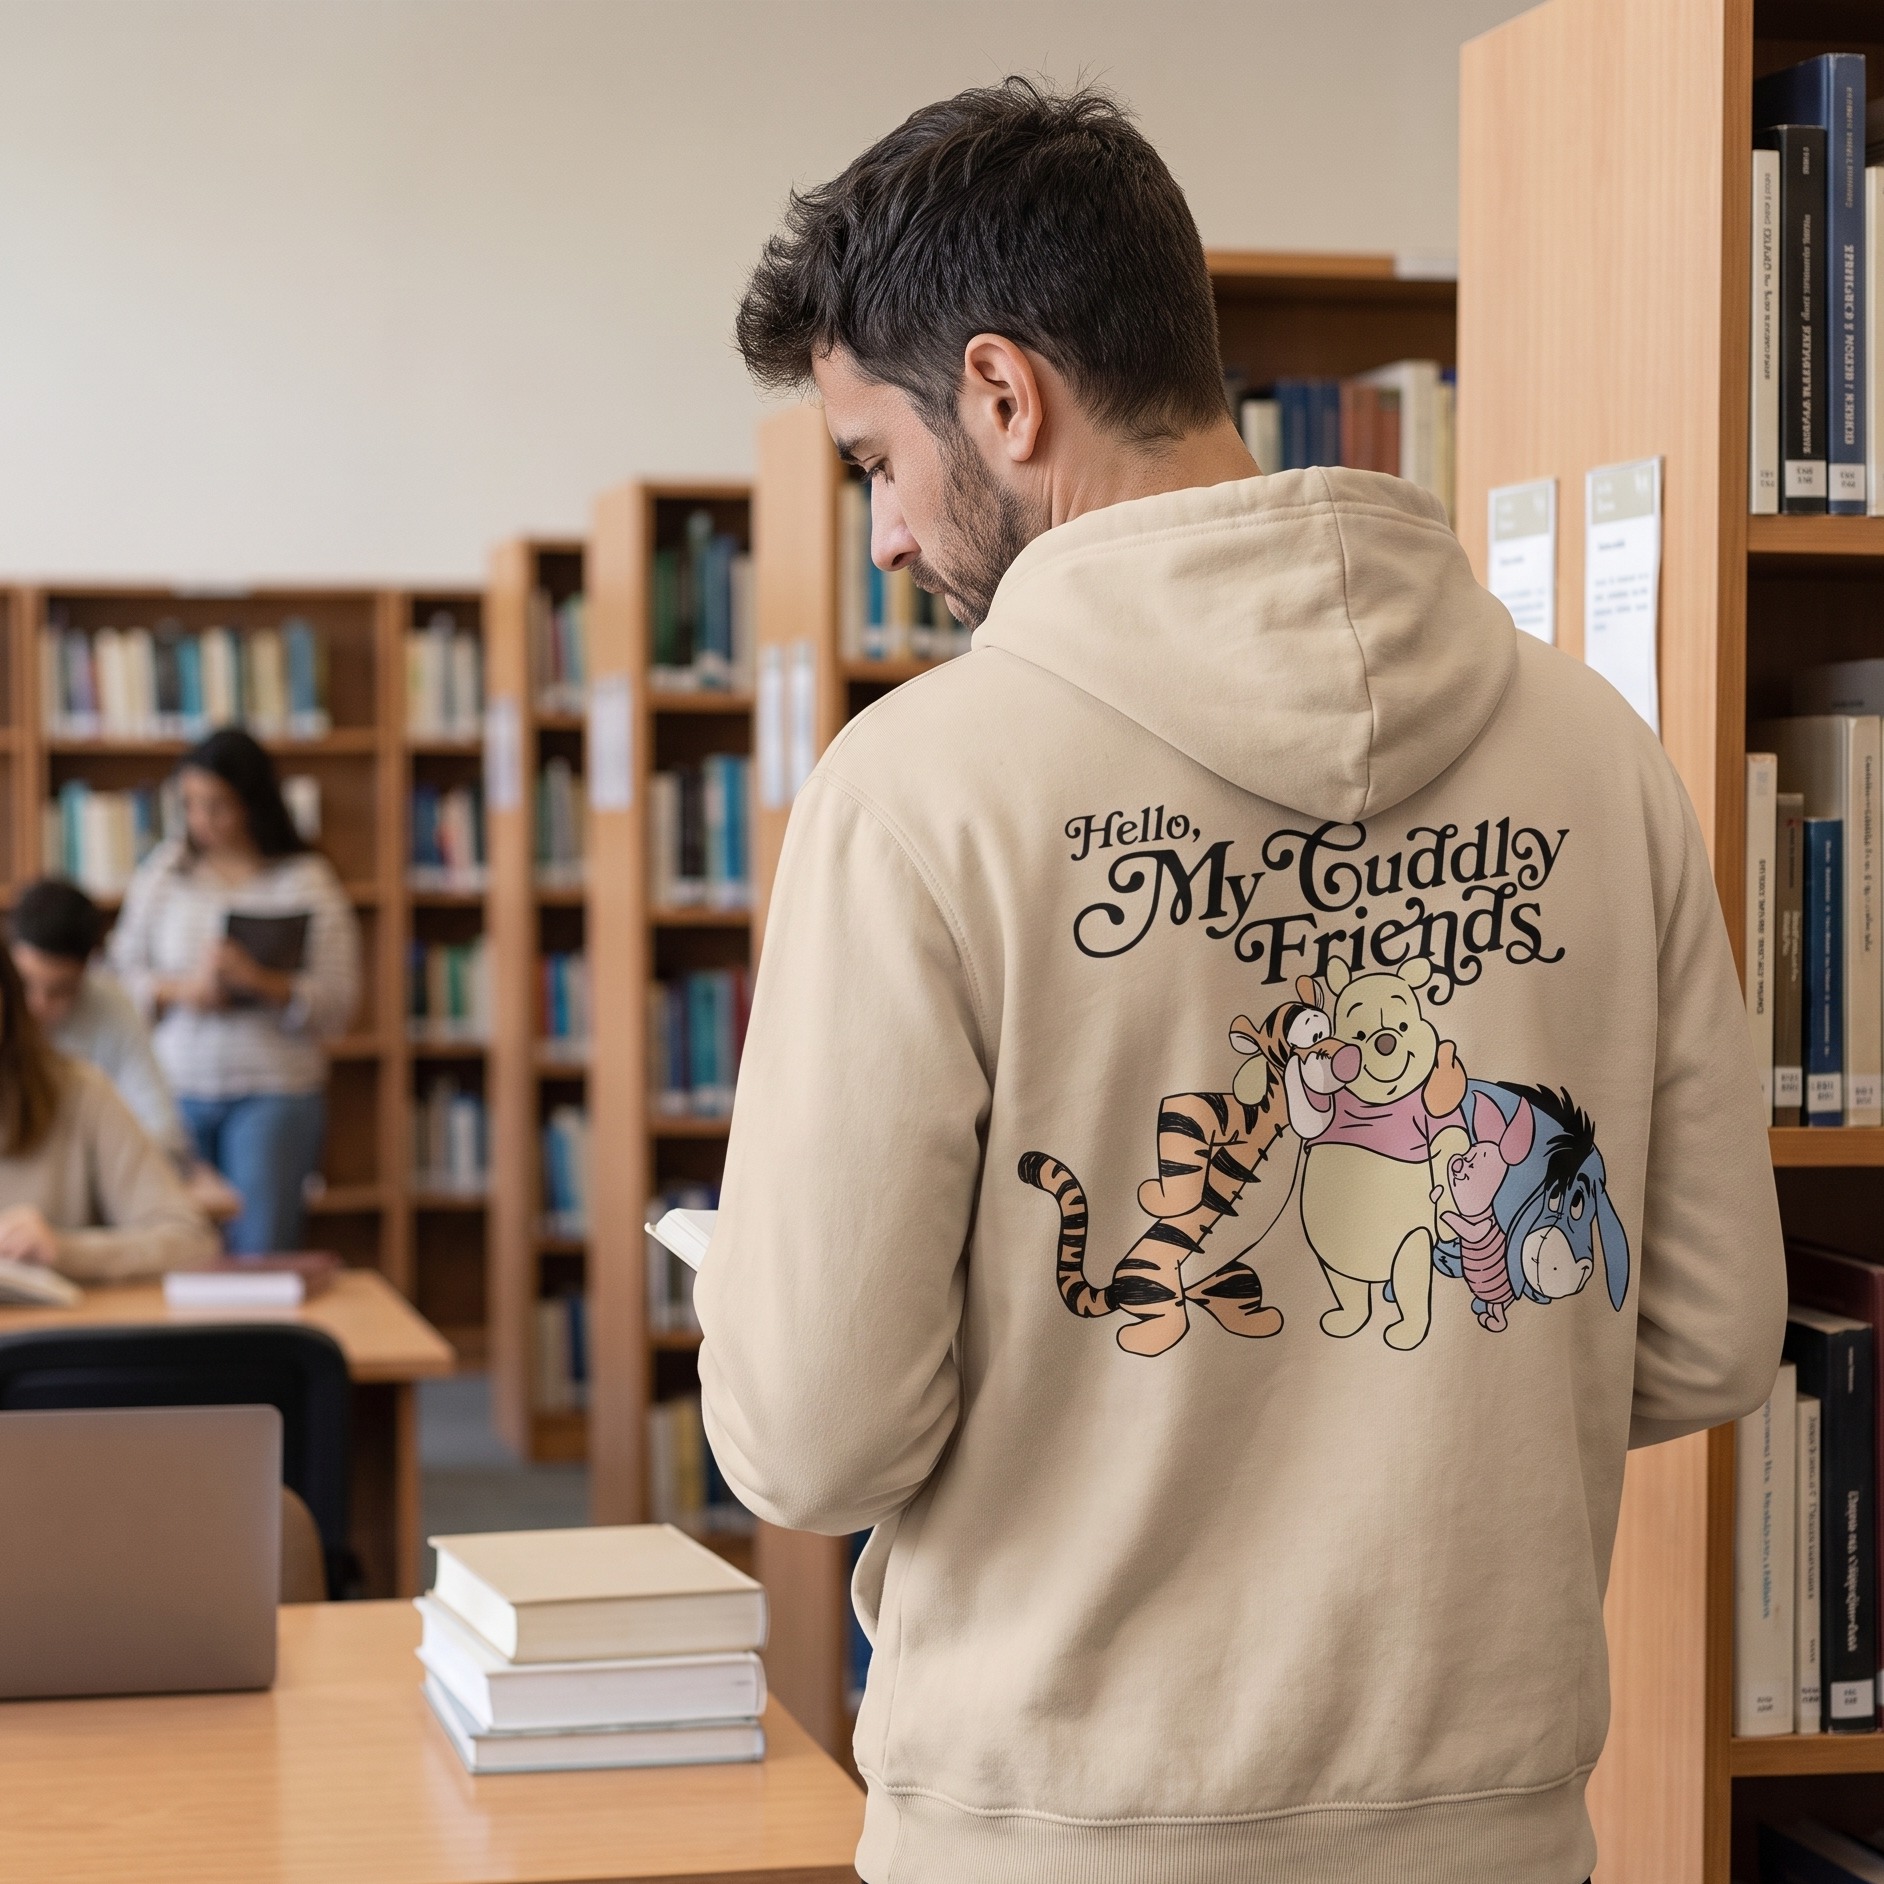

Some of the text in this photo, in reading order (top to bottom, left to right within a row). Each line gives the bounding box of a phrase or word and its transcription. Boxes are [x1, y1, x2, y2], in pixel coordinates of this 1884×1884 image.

[1064, 805, 1201, 861] Hello,
[1073, 816, 1570, 959] My Cuddly
[1234, 882, 1566, 1006] Friends
